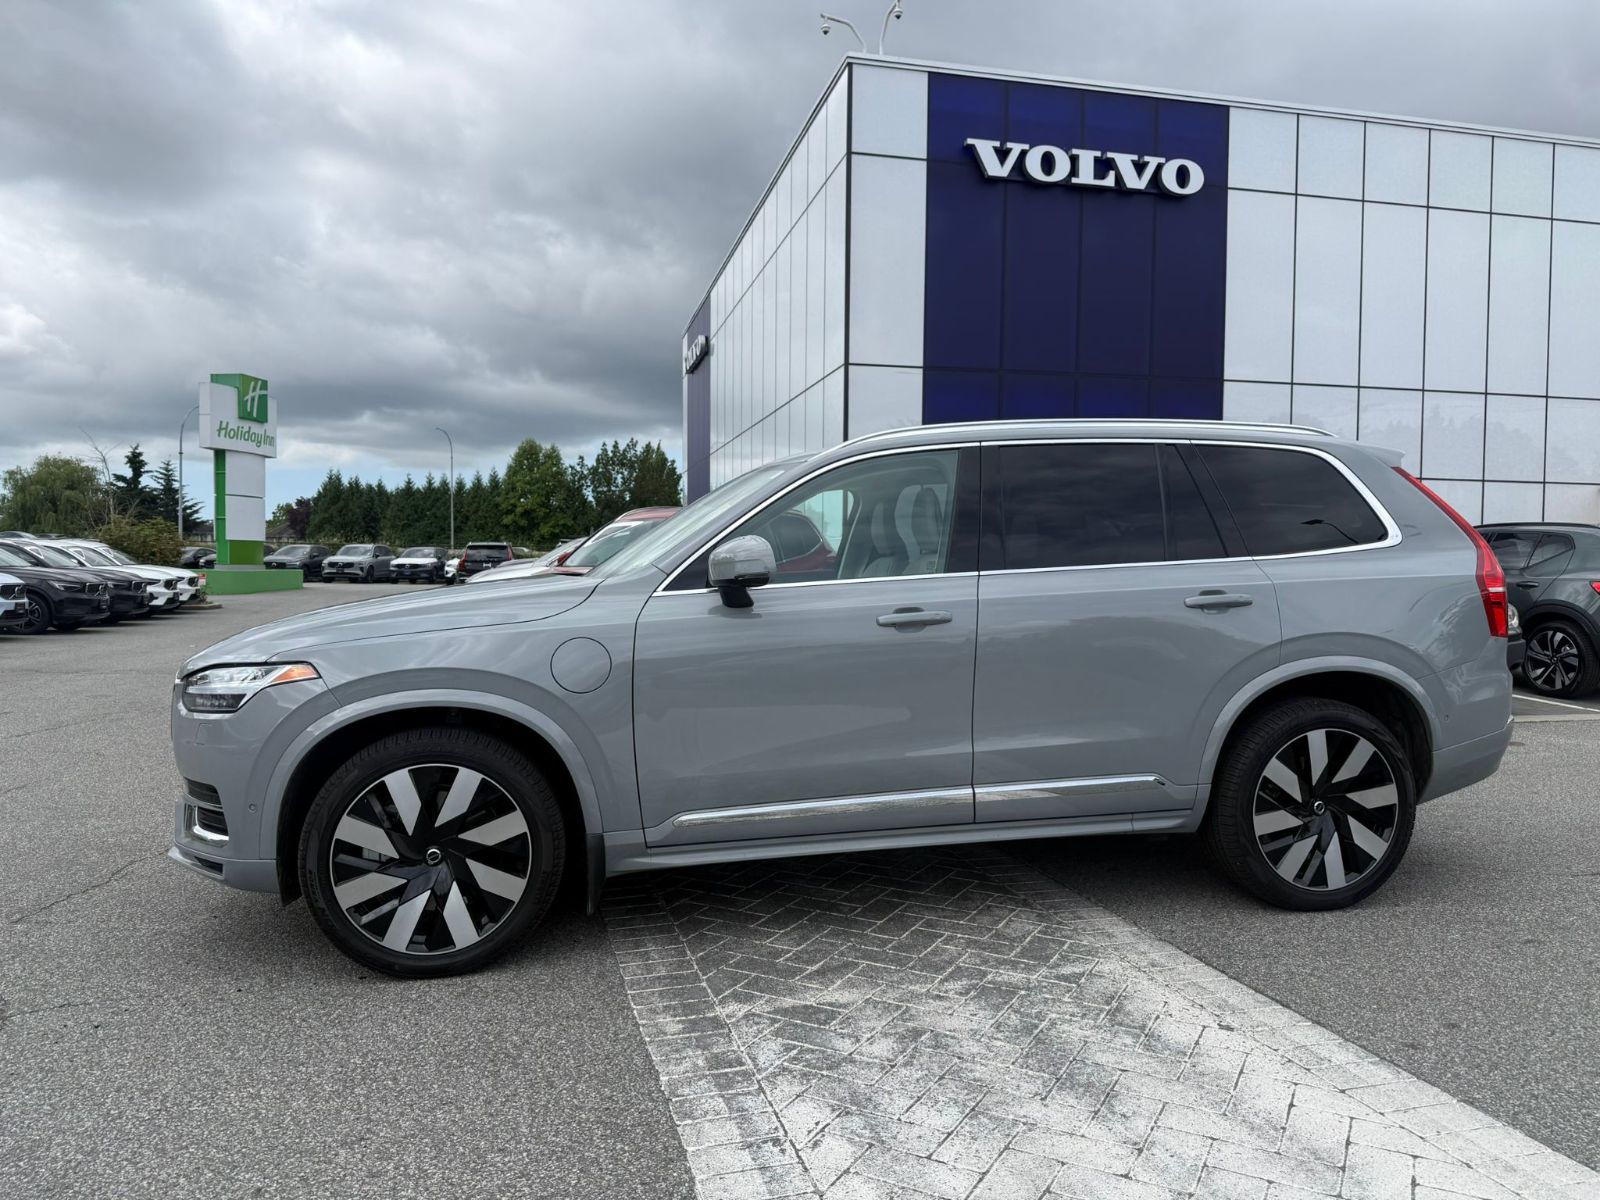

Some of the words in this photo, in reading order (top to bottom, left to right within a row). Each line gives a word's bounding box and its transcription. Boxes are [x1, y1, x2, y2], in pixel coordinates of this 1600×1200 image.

[965, 138, 1205, 196] VOLVO
[216, 420, 263, 448] Holiday
[263, 428, 275, 448] Inn
